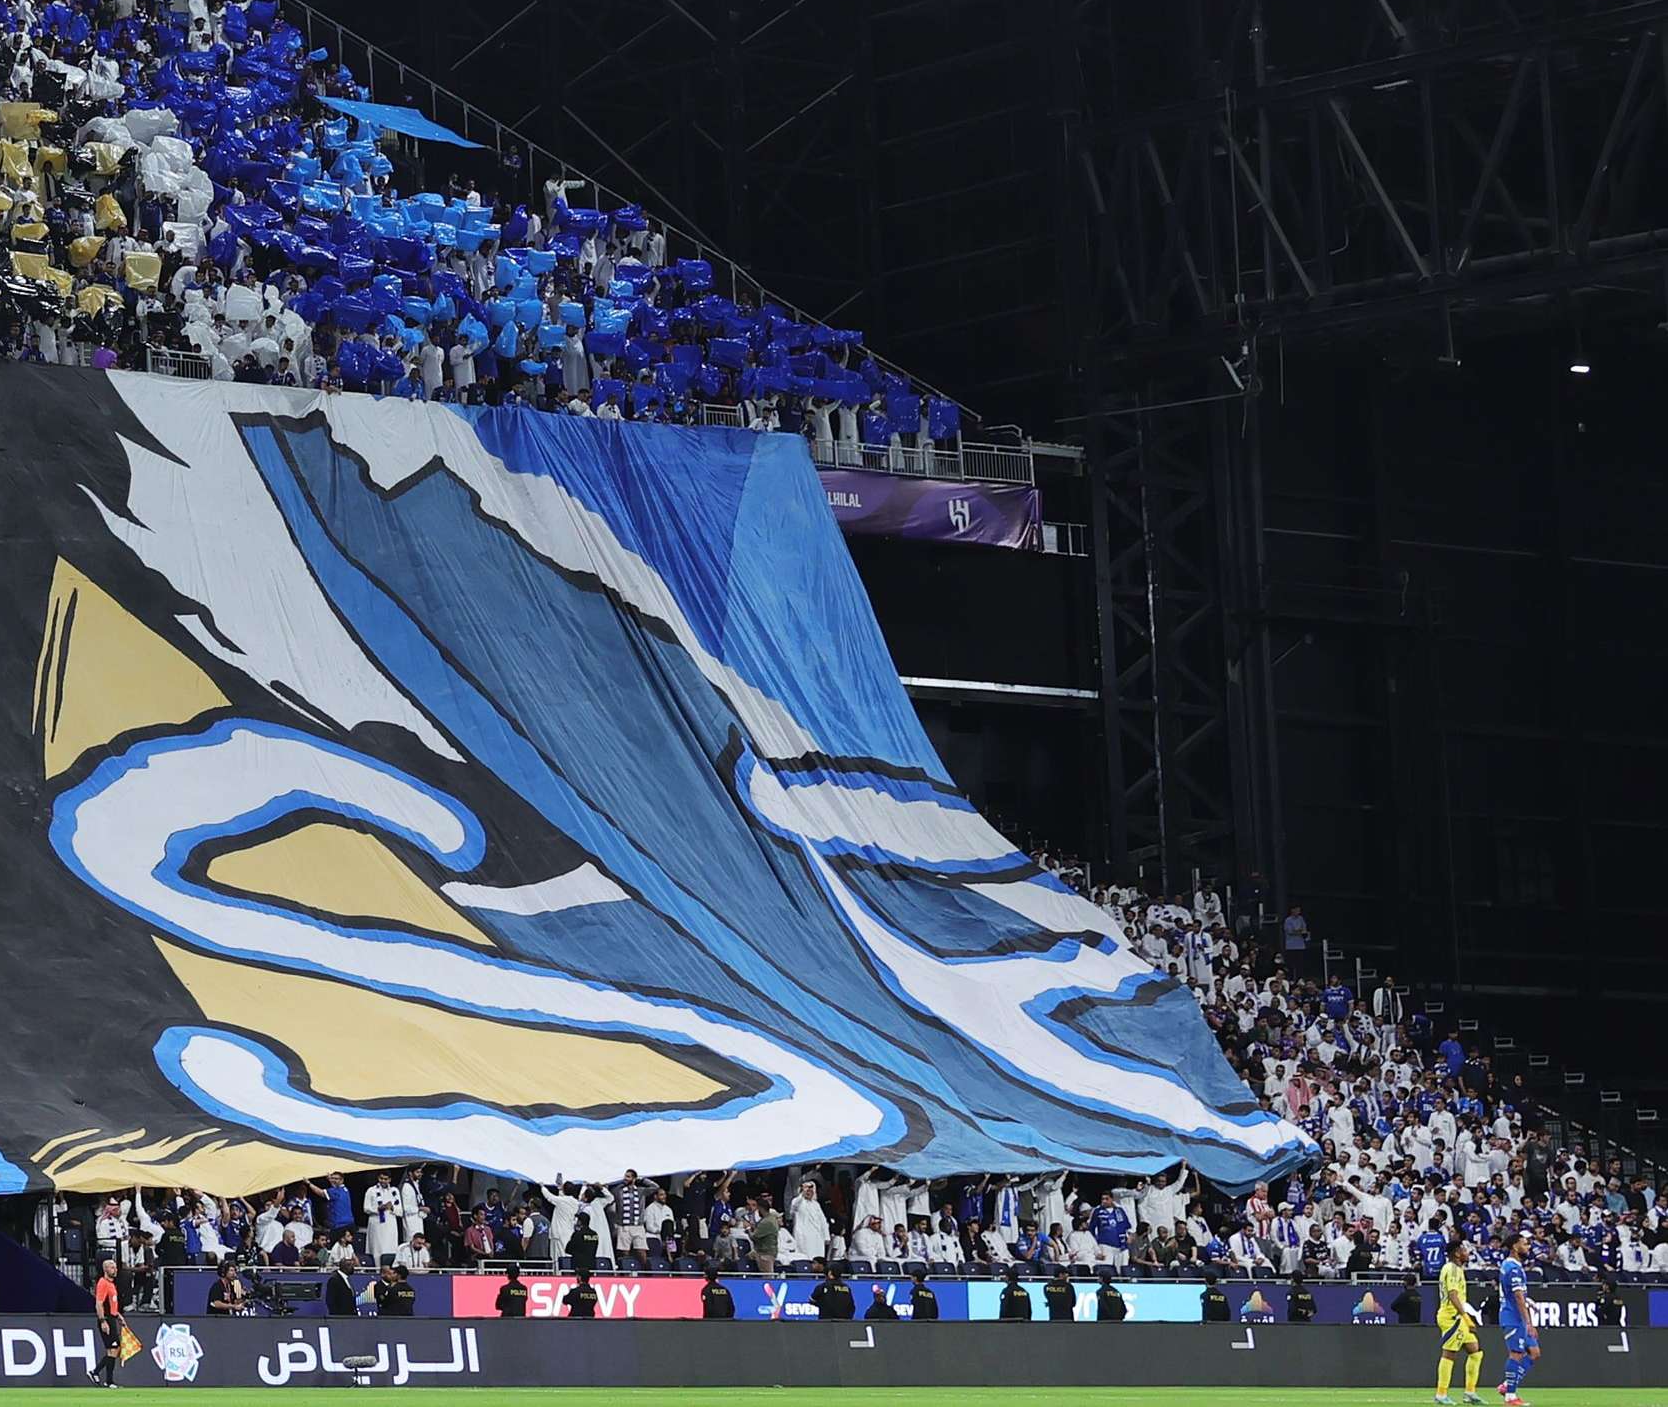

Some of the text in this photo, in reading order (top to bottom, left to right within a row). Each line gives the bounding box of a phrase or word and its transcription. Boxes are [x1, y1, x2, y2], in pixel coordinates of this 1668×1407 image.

[827, 491, 862, 508] LHILAL
[1426, 1247, 1440, 1261] 77
[397, 1290, 415, 1298] POLICE
[510, 1289, 527, 1298] POLICE
[580, 1292, 598, 1301] POLICE
[169, 1347, 186, 1358] RSL
[257, 1327, 480, 1385] الرياض
